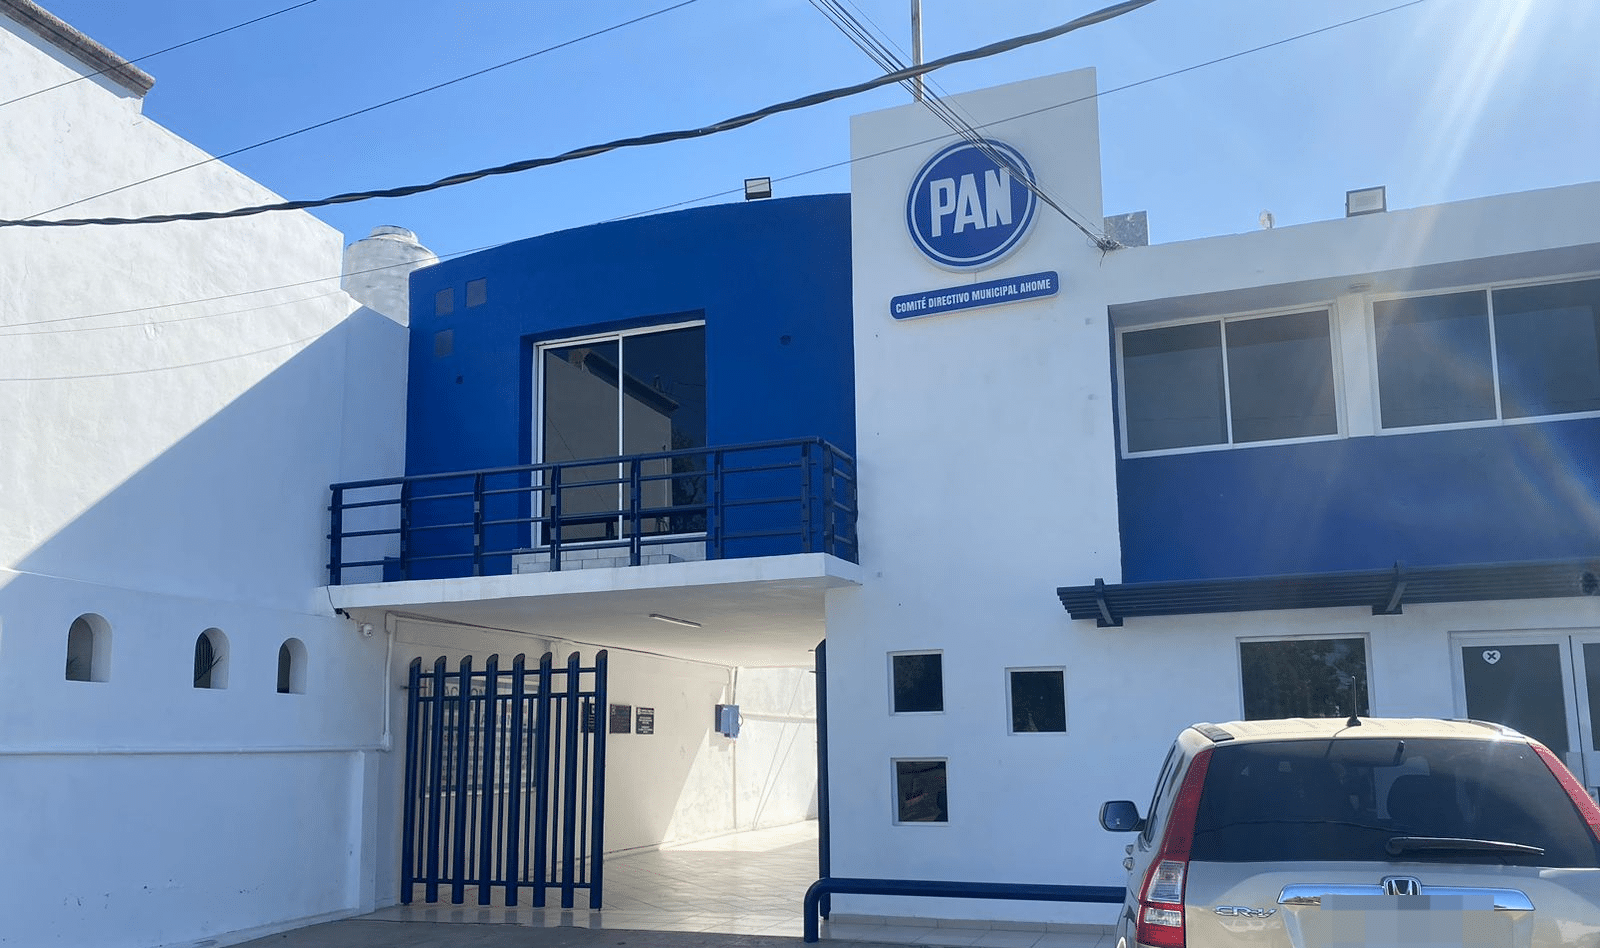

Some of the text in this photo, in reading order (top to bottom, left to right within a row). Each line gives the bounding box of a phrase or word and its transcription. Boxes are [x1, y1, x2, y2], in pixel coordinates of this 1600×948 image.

[930, 168, 1012, 238] PAN
[895, 278, 1051, 314] COMITÉ DIRECTIVO MUNICIPAL AHOME
[1214, 906, 1277, 918] CR-V
